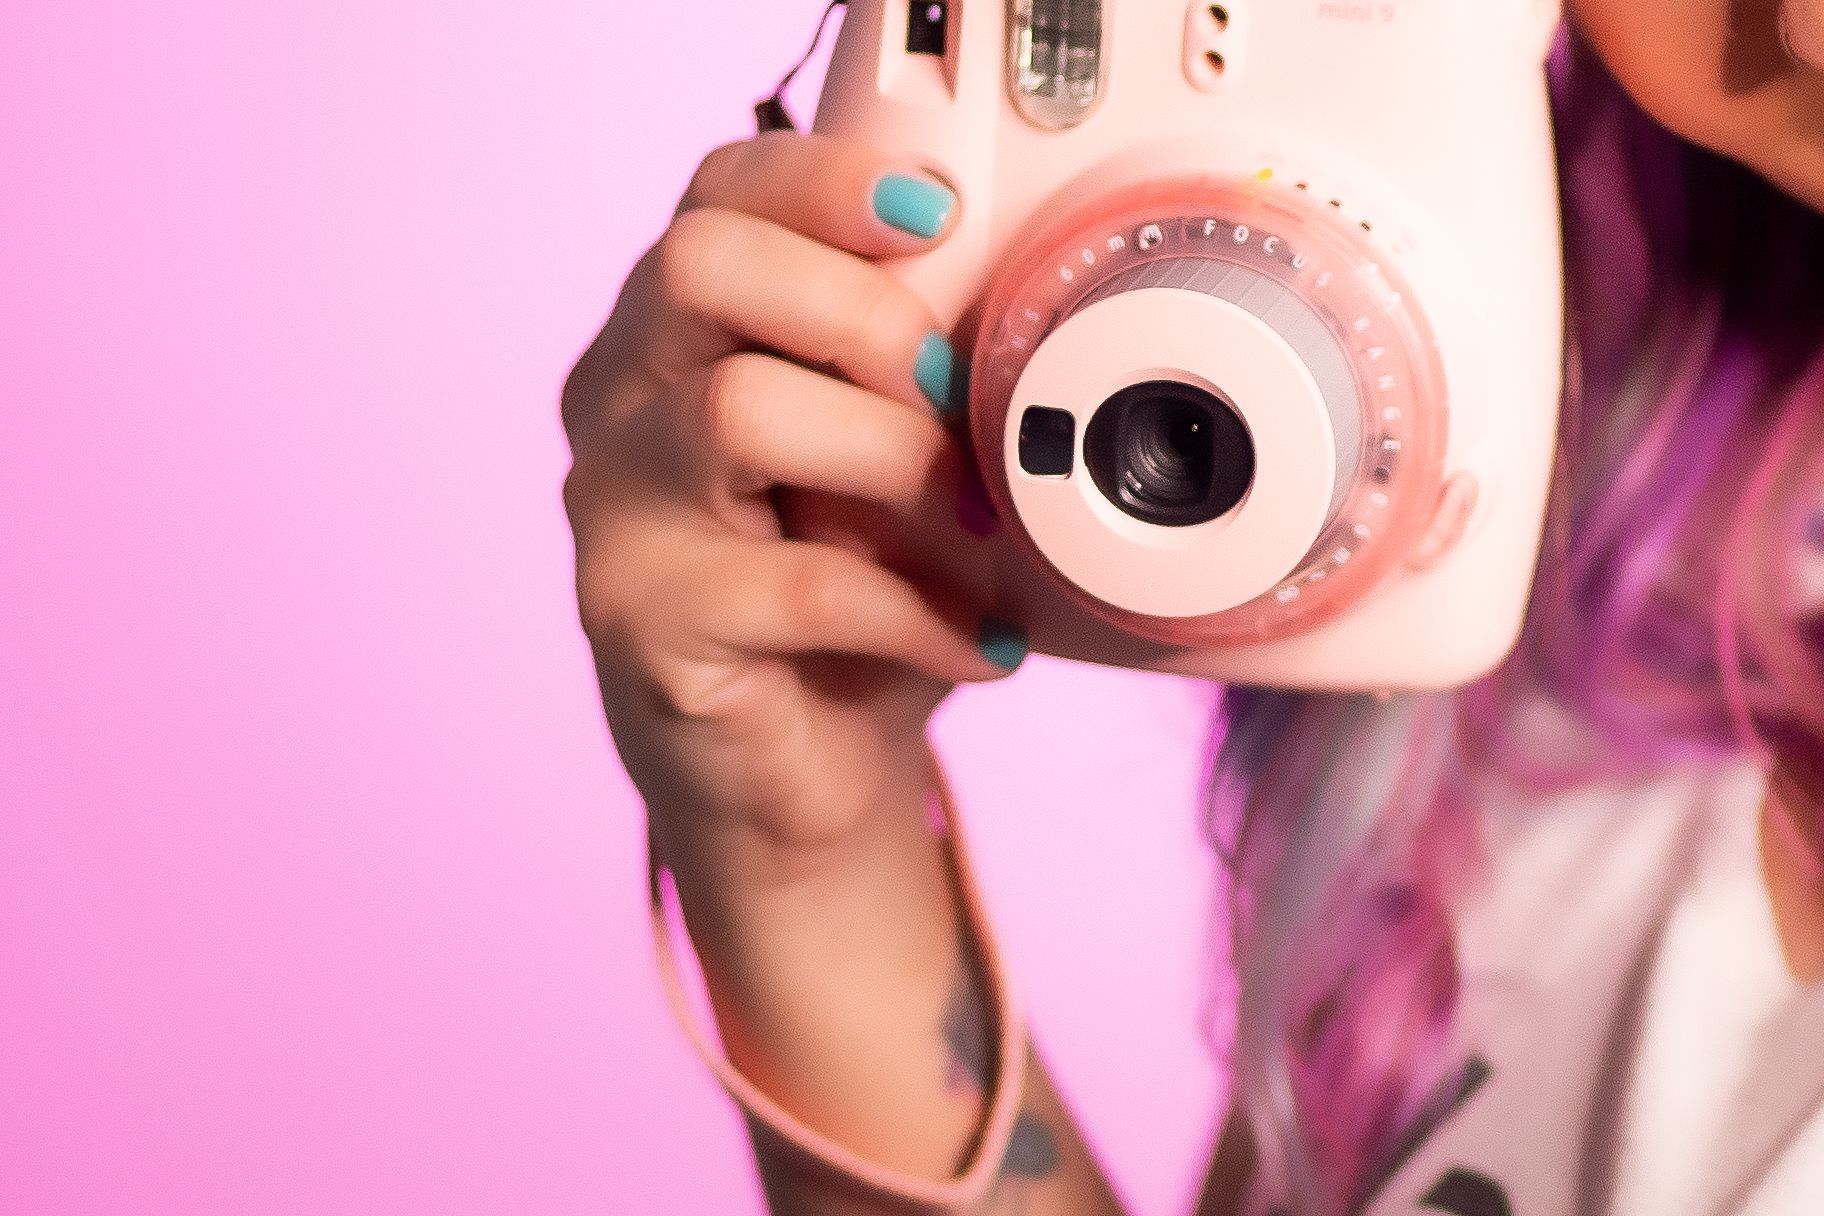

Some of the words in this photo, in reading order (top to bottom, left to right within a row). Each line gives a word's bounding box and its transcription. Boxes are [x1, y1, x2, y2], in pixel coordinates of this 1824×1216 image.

[1318, 2, 1372, 23] mini
[1379, 3, 1394, 23] 9
[1202, 219, 1333, 288] FOCUS
[1354, 316, 1402, 452] RANGE
